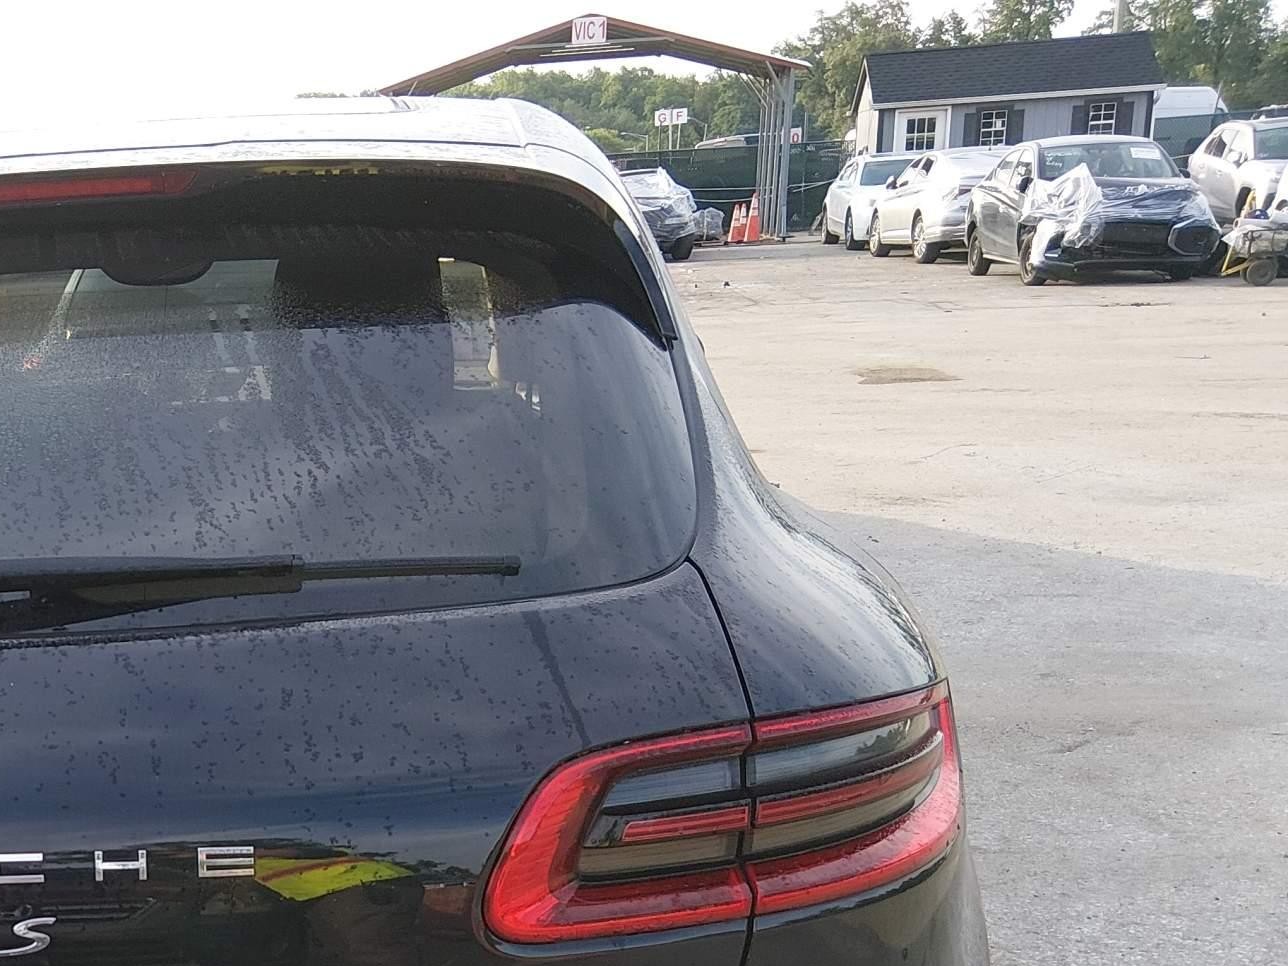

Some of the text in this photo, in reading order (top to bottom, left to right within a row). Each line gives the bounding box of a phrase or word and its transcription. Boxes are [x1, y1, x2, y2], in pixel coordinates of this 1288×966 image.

[574, 20, 606, 40] VIC 1
[658, 112, 667, 123] G
[676, 111, 683, 121] F
